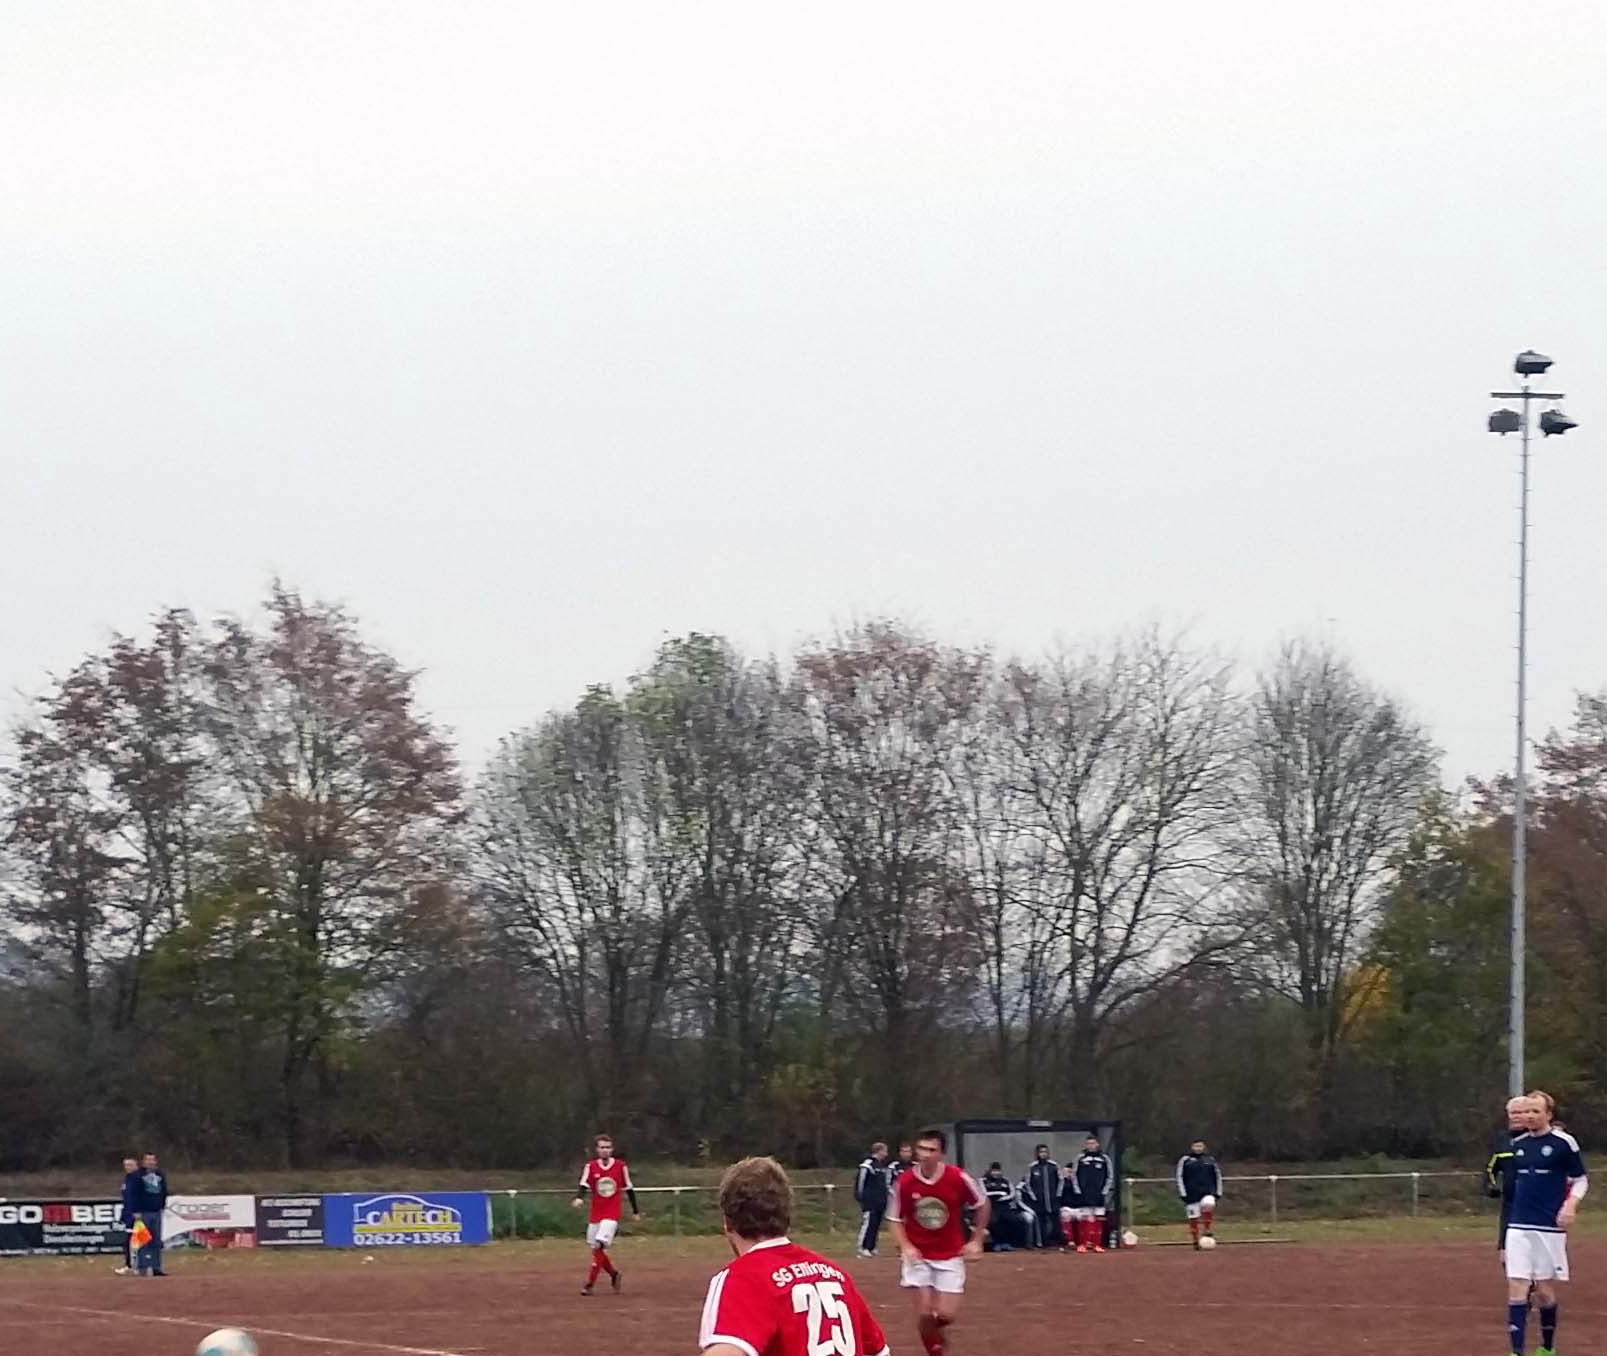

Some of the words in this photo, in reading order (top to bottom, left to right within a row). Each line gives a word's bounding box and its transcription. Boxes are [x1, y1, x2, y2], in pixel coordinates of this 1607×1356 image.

[367, 1210, 452, 1225] CARTECH
[353, 1232, 461, 1245] 02622-13561
[772, 1268, 793, 1287] SG
[790, 1261, 845, 1282] Ellingen
